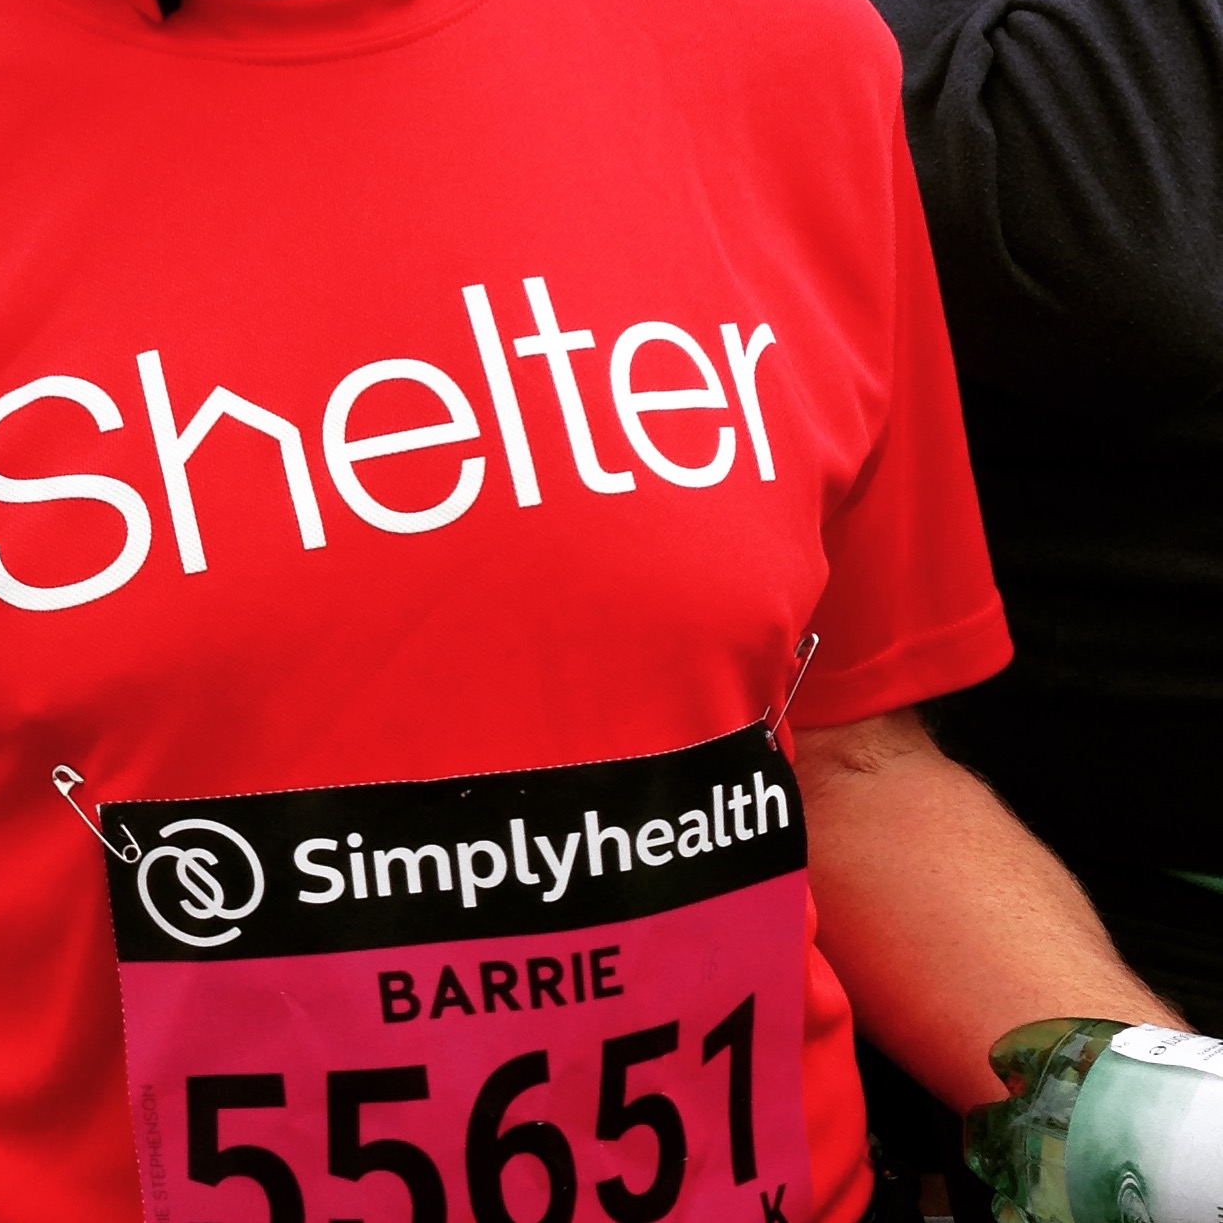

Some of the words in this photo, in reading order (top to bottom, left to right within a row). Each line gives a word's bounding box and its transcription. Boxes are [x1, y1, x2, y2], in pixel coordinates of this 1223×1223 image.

[293, 770, 789, 909] Simplyhealth
[379, 946, 624, 1024] BARRIE
[186, 994, 757, 1223] 55651
